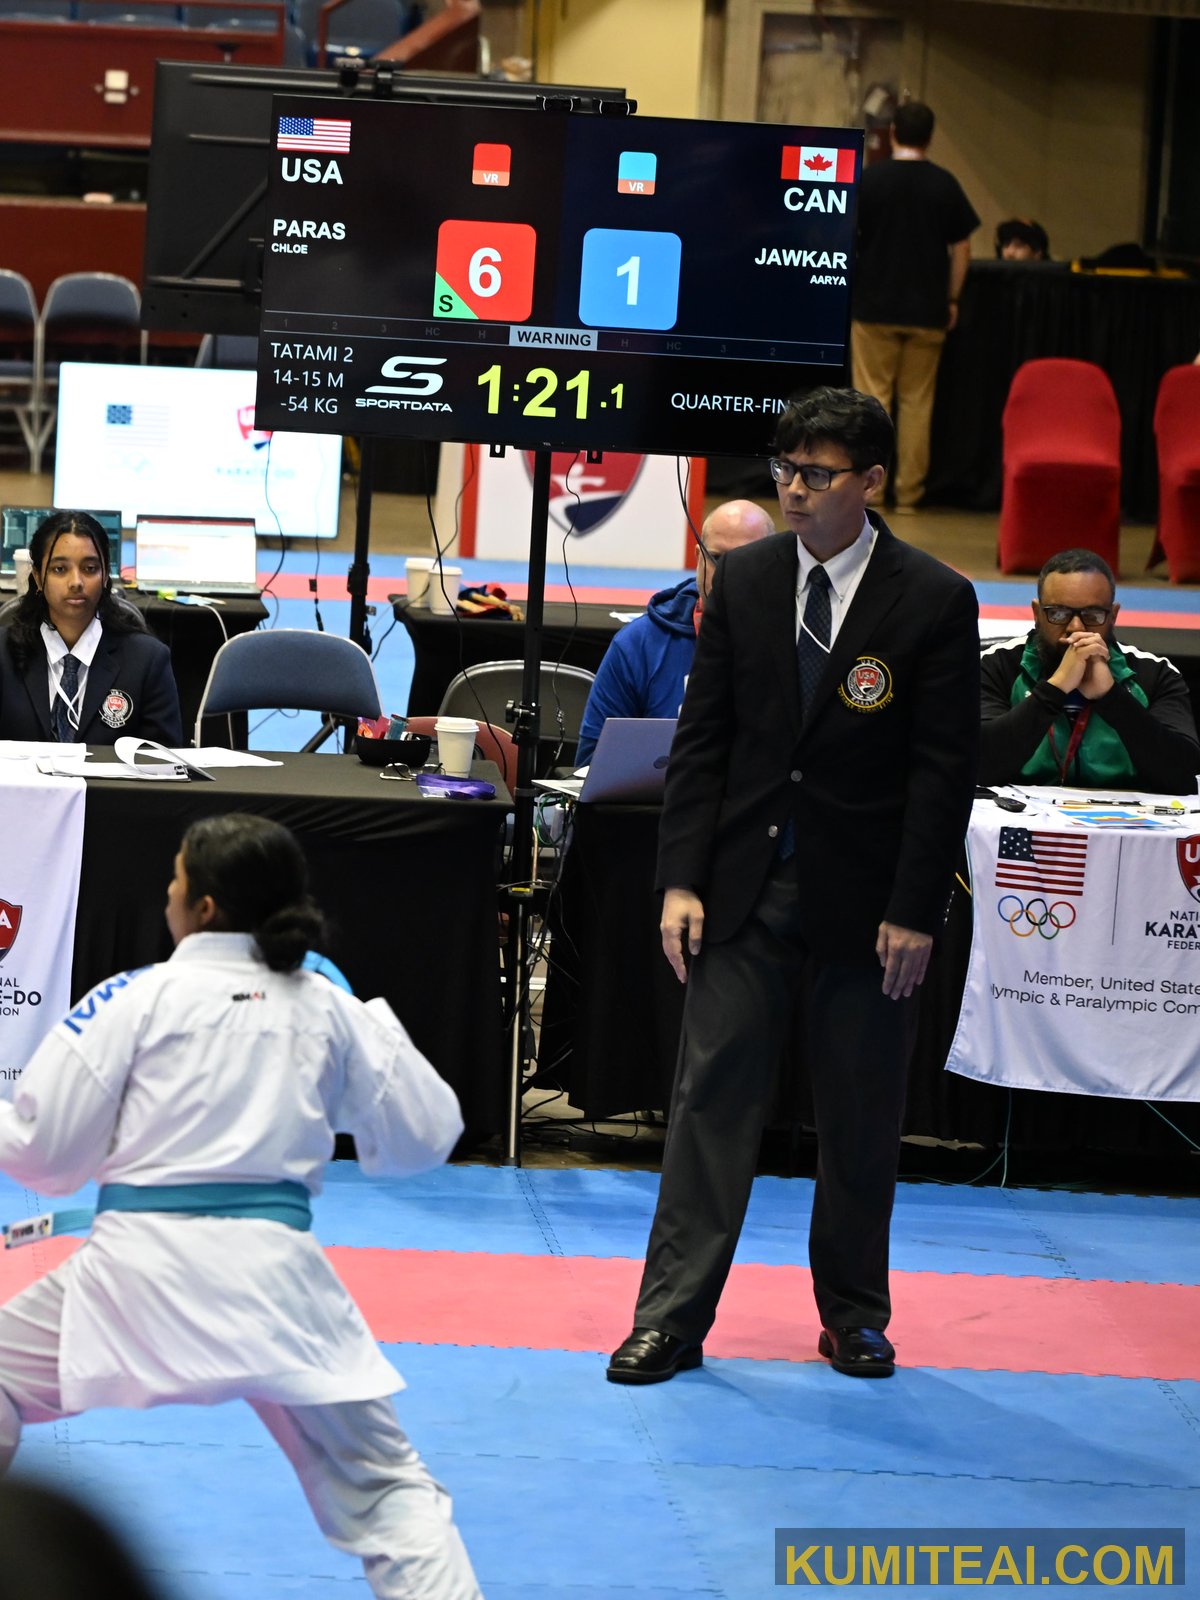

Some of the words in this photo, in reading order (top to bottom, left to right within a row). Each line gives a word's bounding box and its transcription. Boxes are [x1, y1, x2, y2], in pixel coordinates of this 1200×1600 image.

[281, 157, 343, 185] USA
[482, 173, 499, 184] VR
[628, 181, 644, 192] VR
[783, 187, 847, 214] CAN
[273, 219, 346, 240] PARAS
[271, 243, 308, 254] CHLOE
[754, 248, 847, 269] JAWKAR
[468, 247, 502, 298] 6
[616, 256, 640, 305] 1
[810, 274, 847, 286] AARYA
[438, 295, 453, 313] S
[331, 322, 338, 330] 2
[381, 324, 387, 333] 3
[425, 326, 440, 336] HC
[479, 330, 486, 339] H
[517, 330, 591, 347] WARNING
[621, 339, 629, 348] H
[666, 341, 681, 351] HC
[270, 342, 337, 361] TATAMI
[343, 347, 353, 362] 2
[273, 369, 321, 386] 14-15
[328, 373, 344, 388] M
[280, 396, 308, 412] -54
[315, 398, 338, 414] KG
[355, 398, 453, 413] SPORTDATA
[671, 393, 790, 414] QUARTER-FIN
[1023, 970, 1093, 990] Member,
[1101, 977, 1154, 993] United
[991, 984, 1045, 1005] lympic
[1050, 993, 1061, 1006] &
[1066, 994, 1157, 1014] Paralympic
